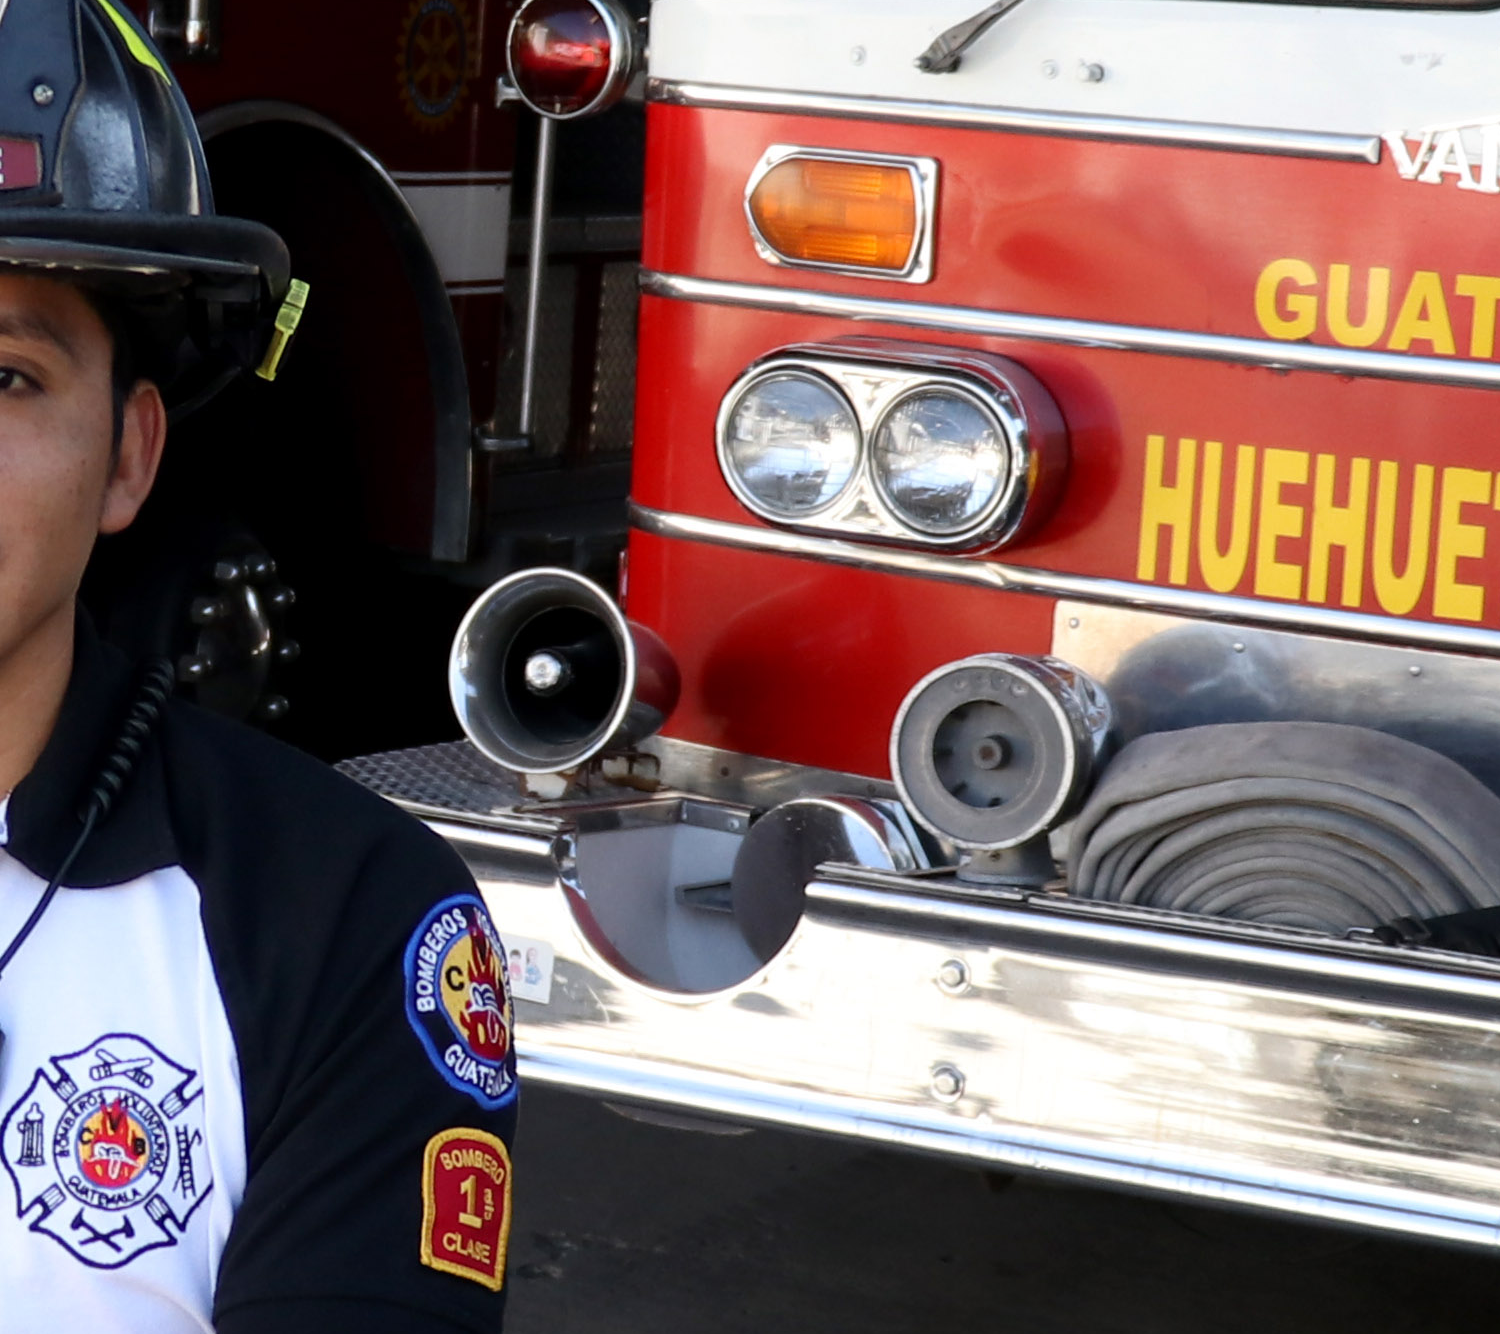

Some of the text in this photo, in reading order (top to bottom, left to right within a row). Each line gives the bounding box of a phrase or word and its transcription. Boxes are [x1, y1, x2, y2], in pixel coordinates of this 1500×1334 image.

[416, 908, 468, 1013] BOMBEROS
[445, 965, 465, 992] C
[439, 1149, 505, 1186] BOMBERO
[442, 1231, 491, 1265] CLASE
